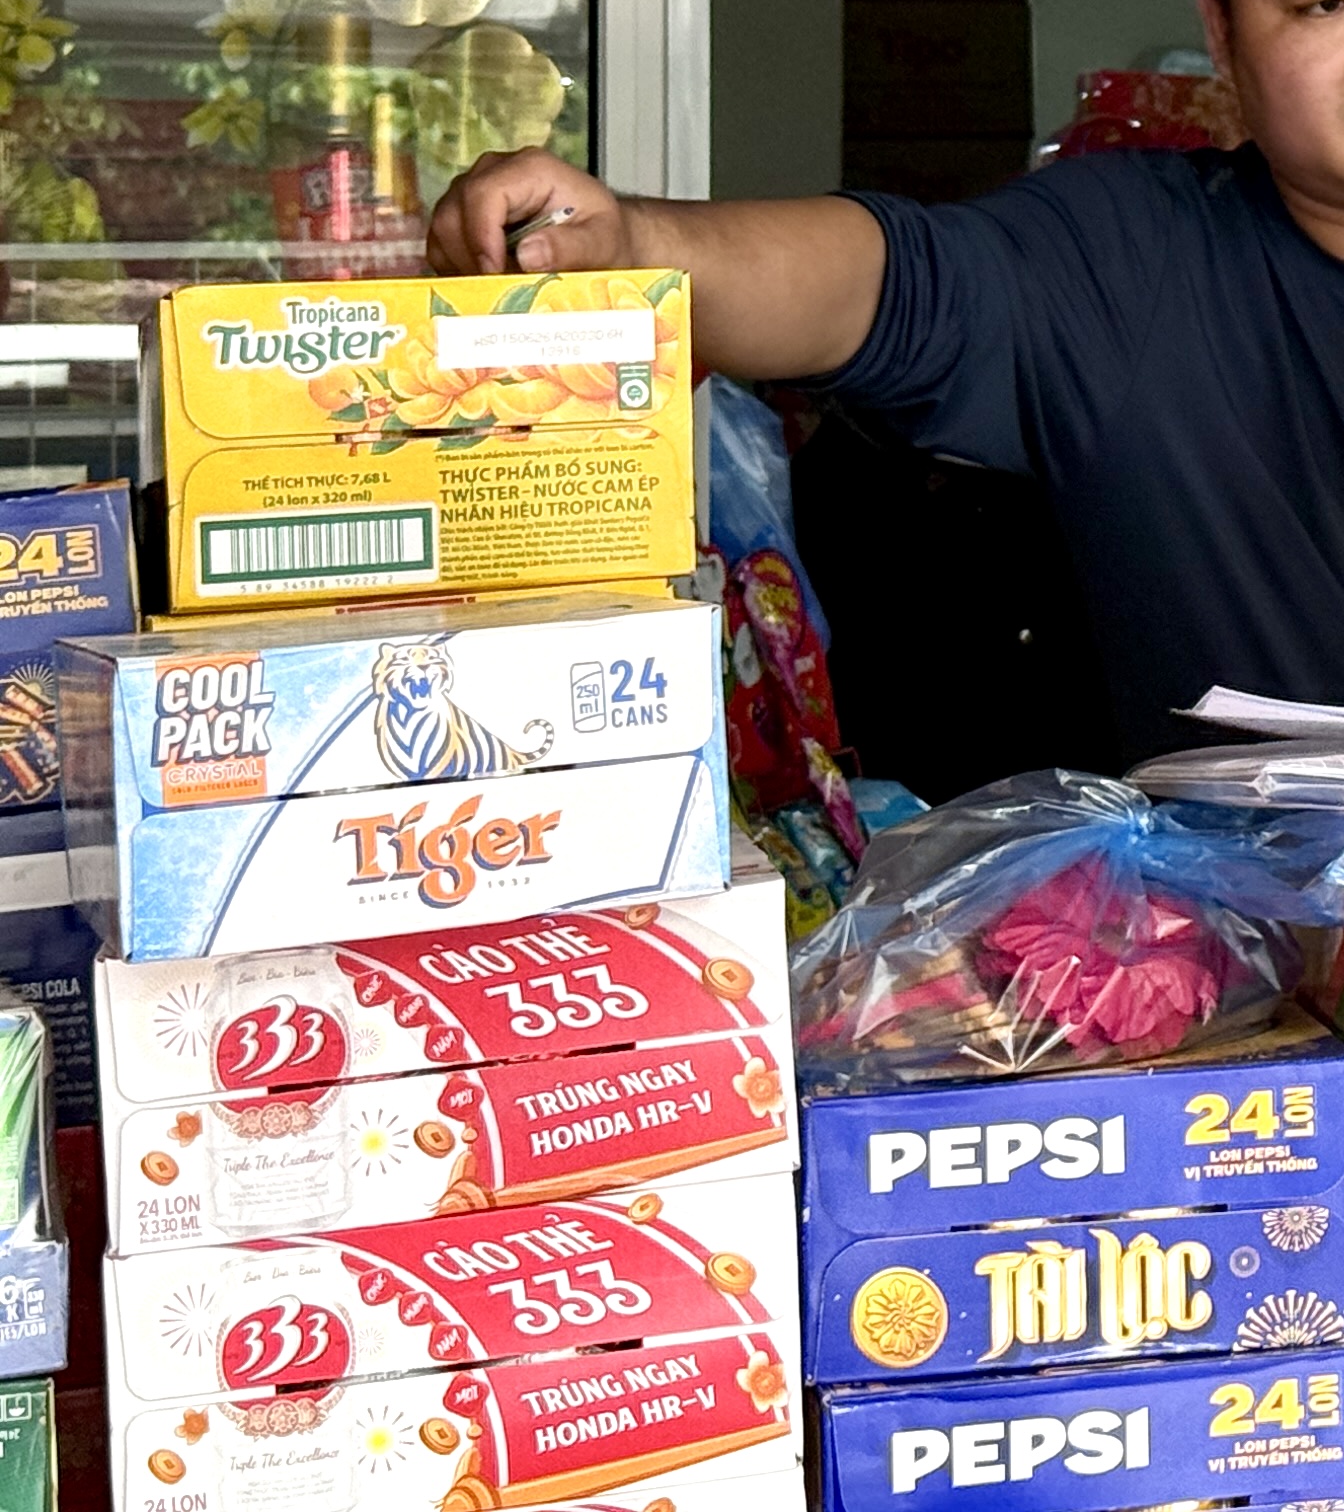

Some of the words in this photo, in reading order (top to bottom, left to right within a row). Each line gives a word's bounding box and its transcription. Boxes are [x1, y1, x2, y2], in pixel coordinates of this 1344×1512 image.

[286, 301, 379, 327] Tropicana
[207, 325, 396, 374] Twister
[350, 472, 380, 486] 7,68
[383, 472, 391, 483] L
[439, 465, 491, 487] THỰC
[585, 459, 643, 476] SUNG:
[440, 485, 520, 505] TWISTER
[533, 479, 588, 499] NƯỚC
[592, 478, 633, 495] CAM
[638, 474, 660, 492] ÉP
[263, 494, 285, 508] (24
[287, 492, 308, 506] lon
[311, 495, 320, 505] x
[322, 492, 347, 504] 320
[350, 489, 372, 503] ml)
[546, 496, 652, 517] TROPICANA
[67, 530, 95, 576] LON
[32, 586, 79, 599] PEPSI
[157, 660, 276, 714] COOL
[576, 683, 600, 699] 250
[609, 656, 668, 703] 24
[579, 698, 599, 714] ml
[611, 703, 668, 728] CANS
[152, 707, 275, 766] PACK
[167, 760, 262, 785] CRYSTAL
[333, 794, 563, 909] Tiger
[358, 890, 410, 904] SINCE
[488, 876, 531, 889] 1932
[46, 978, 81, 1000] COLA
[483, 964, 650, 1038] 333
[226, 994, 326, 1082] 333
[515, 1082, 620, 1121] TRÚNG
[617, 1059, 698, 1098] NGAY
[530, 1111, 634, 1158] HONDA
[636, 1090, 713, 1128] HR-V
[1184, 1089, 1280, 1146] 24
[1283, 1086, 1315, 1138] LON
[869, 1114, 1126, 1193] PEPSI
[1210, 1147, 1241, 1163] LON
[1244, 1144, 1290, 1160] PEPSI
[137, 1198, 160, 1219] 24
[164, 1194, 201, 1216] LON
[139, 1220, 149, 1237] X
[150, 1217, 178, 1236] 330
[487, 1259, 653, 1335] 333
[232, 1294, 330, 1382] 333
[623, 1354, 703, 1392] NGAY
[534, 1407, 638, 1455] HONDA
[641, 1384, 717, 1423] HR-V
[1209, 1378, 1305, 1437] 24
[1308, 1374, 1340, 1427] LON
[890, 1407, 1151, 1494] PEPSI
[1234, 1440, 1267, 1455] LON
[1269, 1434, 1316, 1451] PEPSI
